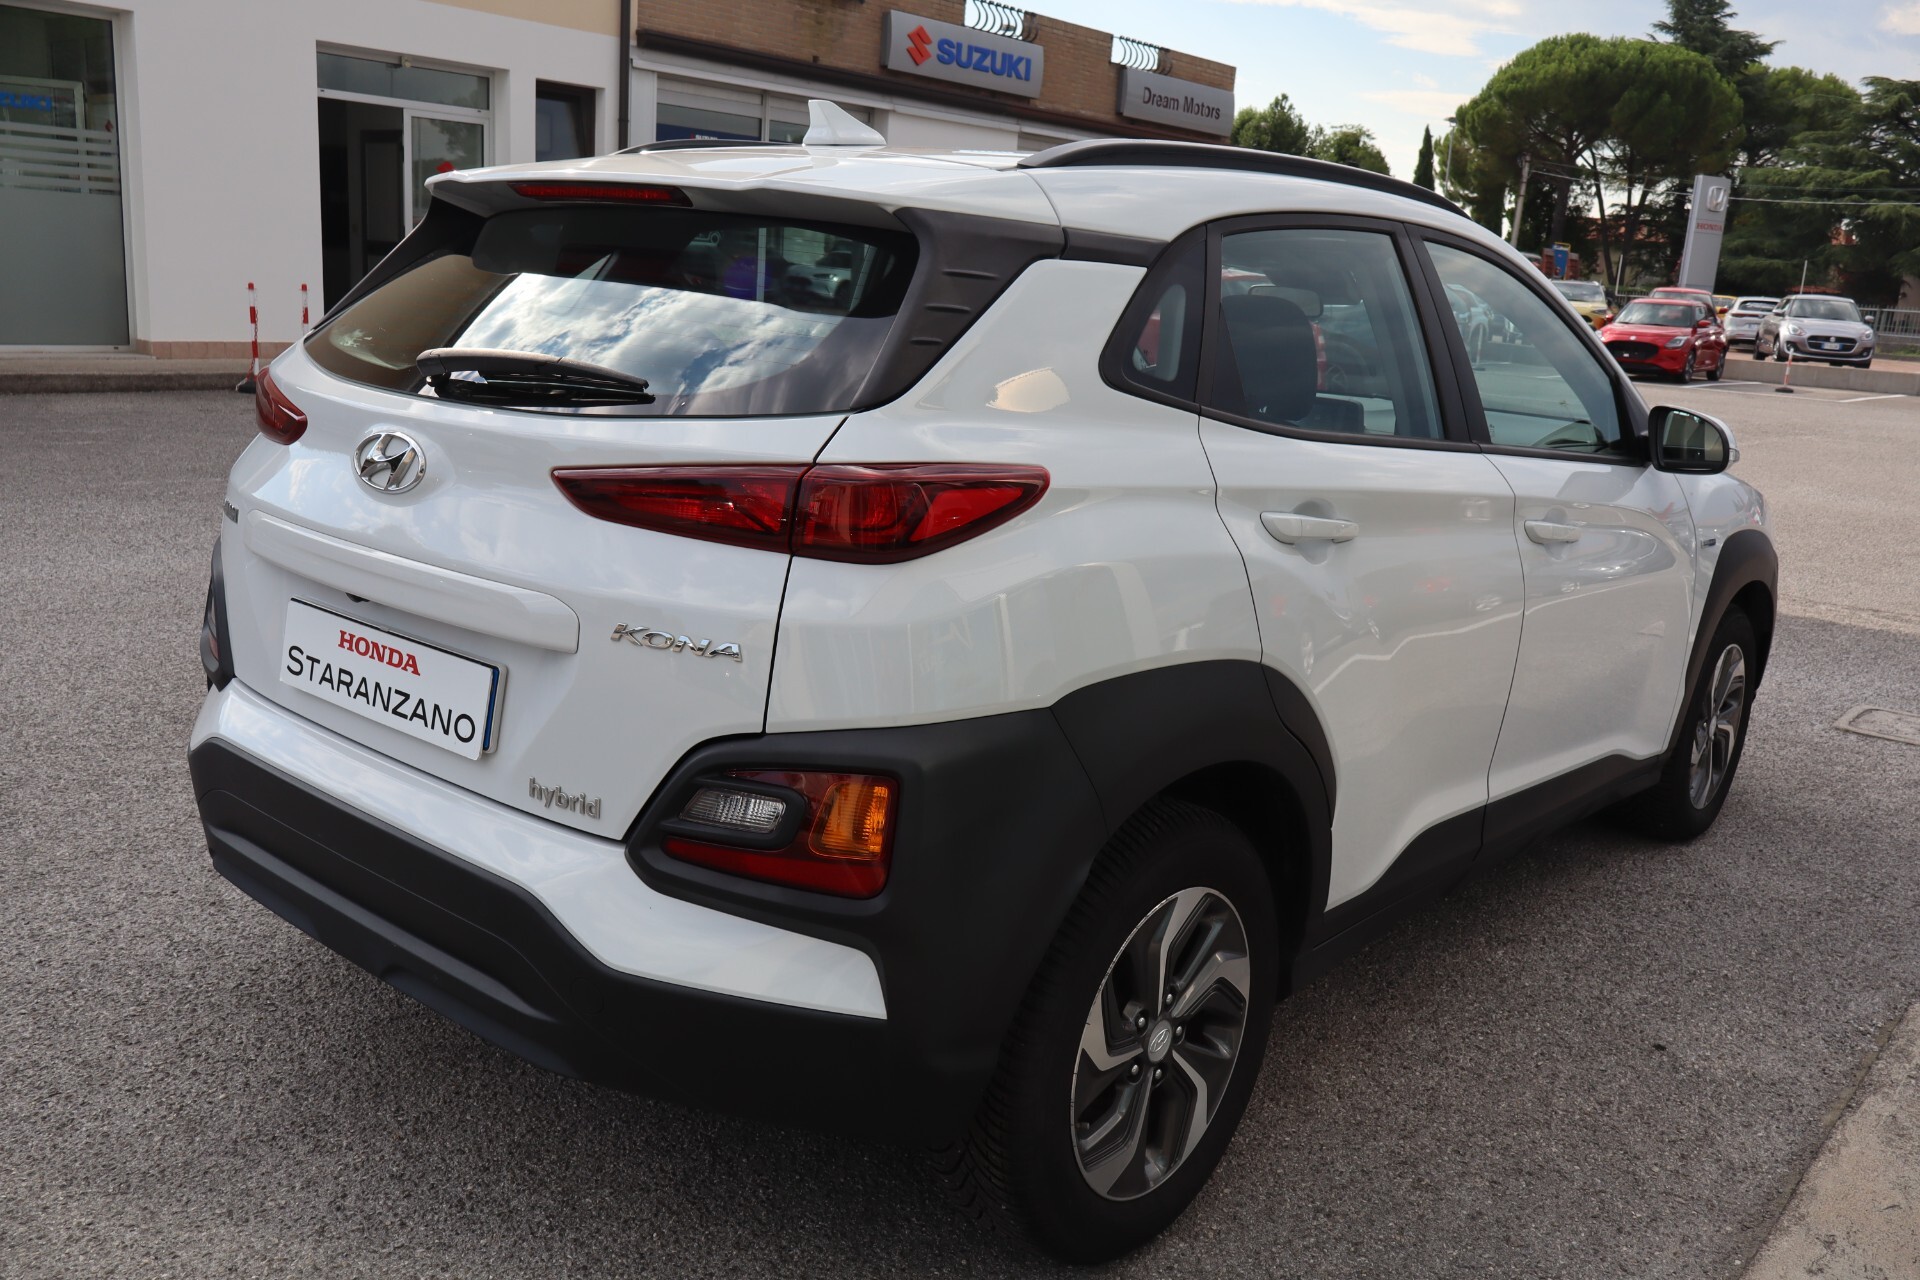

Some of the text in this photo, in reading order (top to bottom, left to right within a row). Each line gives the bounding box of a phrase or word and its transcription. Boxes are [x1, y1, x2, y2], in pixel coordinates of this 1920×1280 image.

[936, 37, 1032, 82] SUZUKI
[1142, 86, 1221, 120] Dream Motors
[1696, 222, 1723, 232] HONDA
[337, 629, 421, 677] HONDA
[610, 622, 743, 663] KONA
[286, 645, 477, 744] STARANZANO
[528, 776, 601, 820] hybrid
